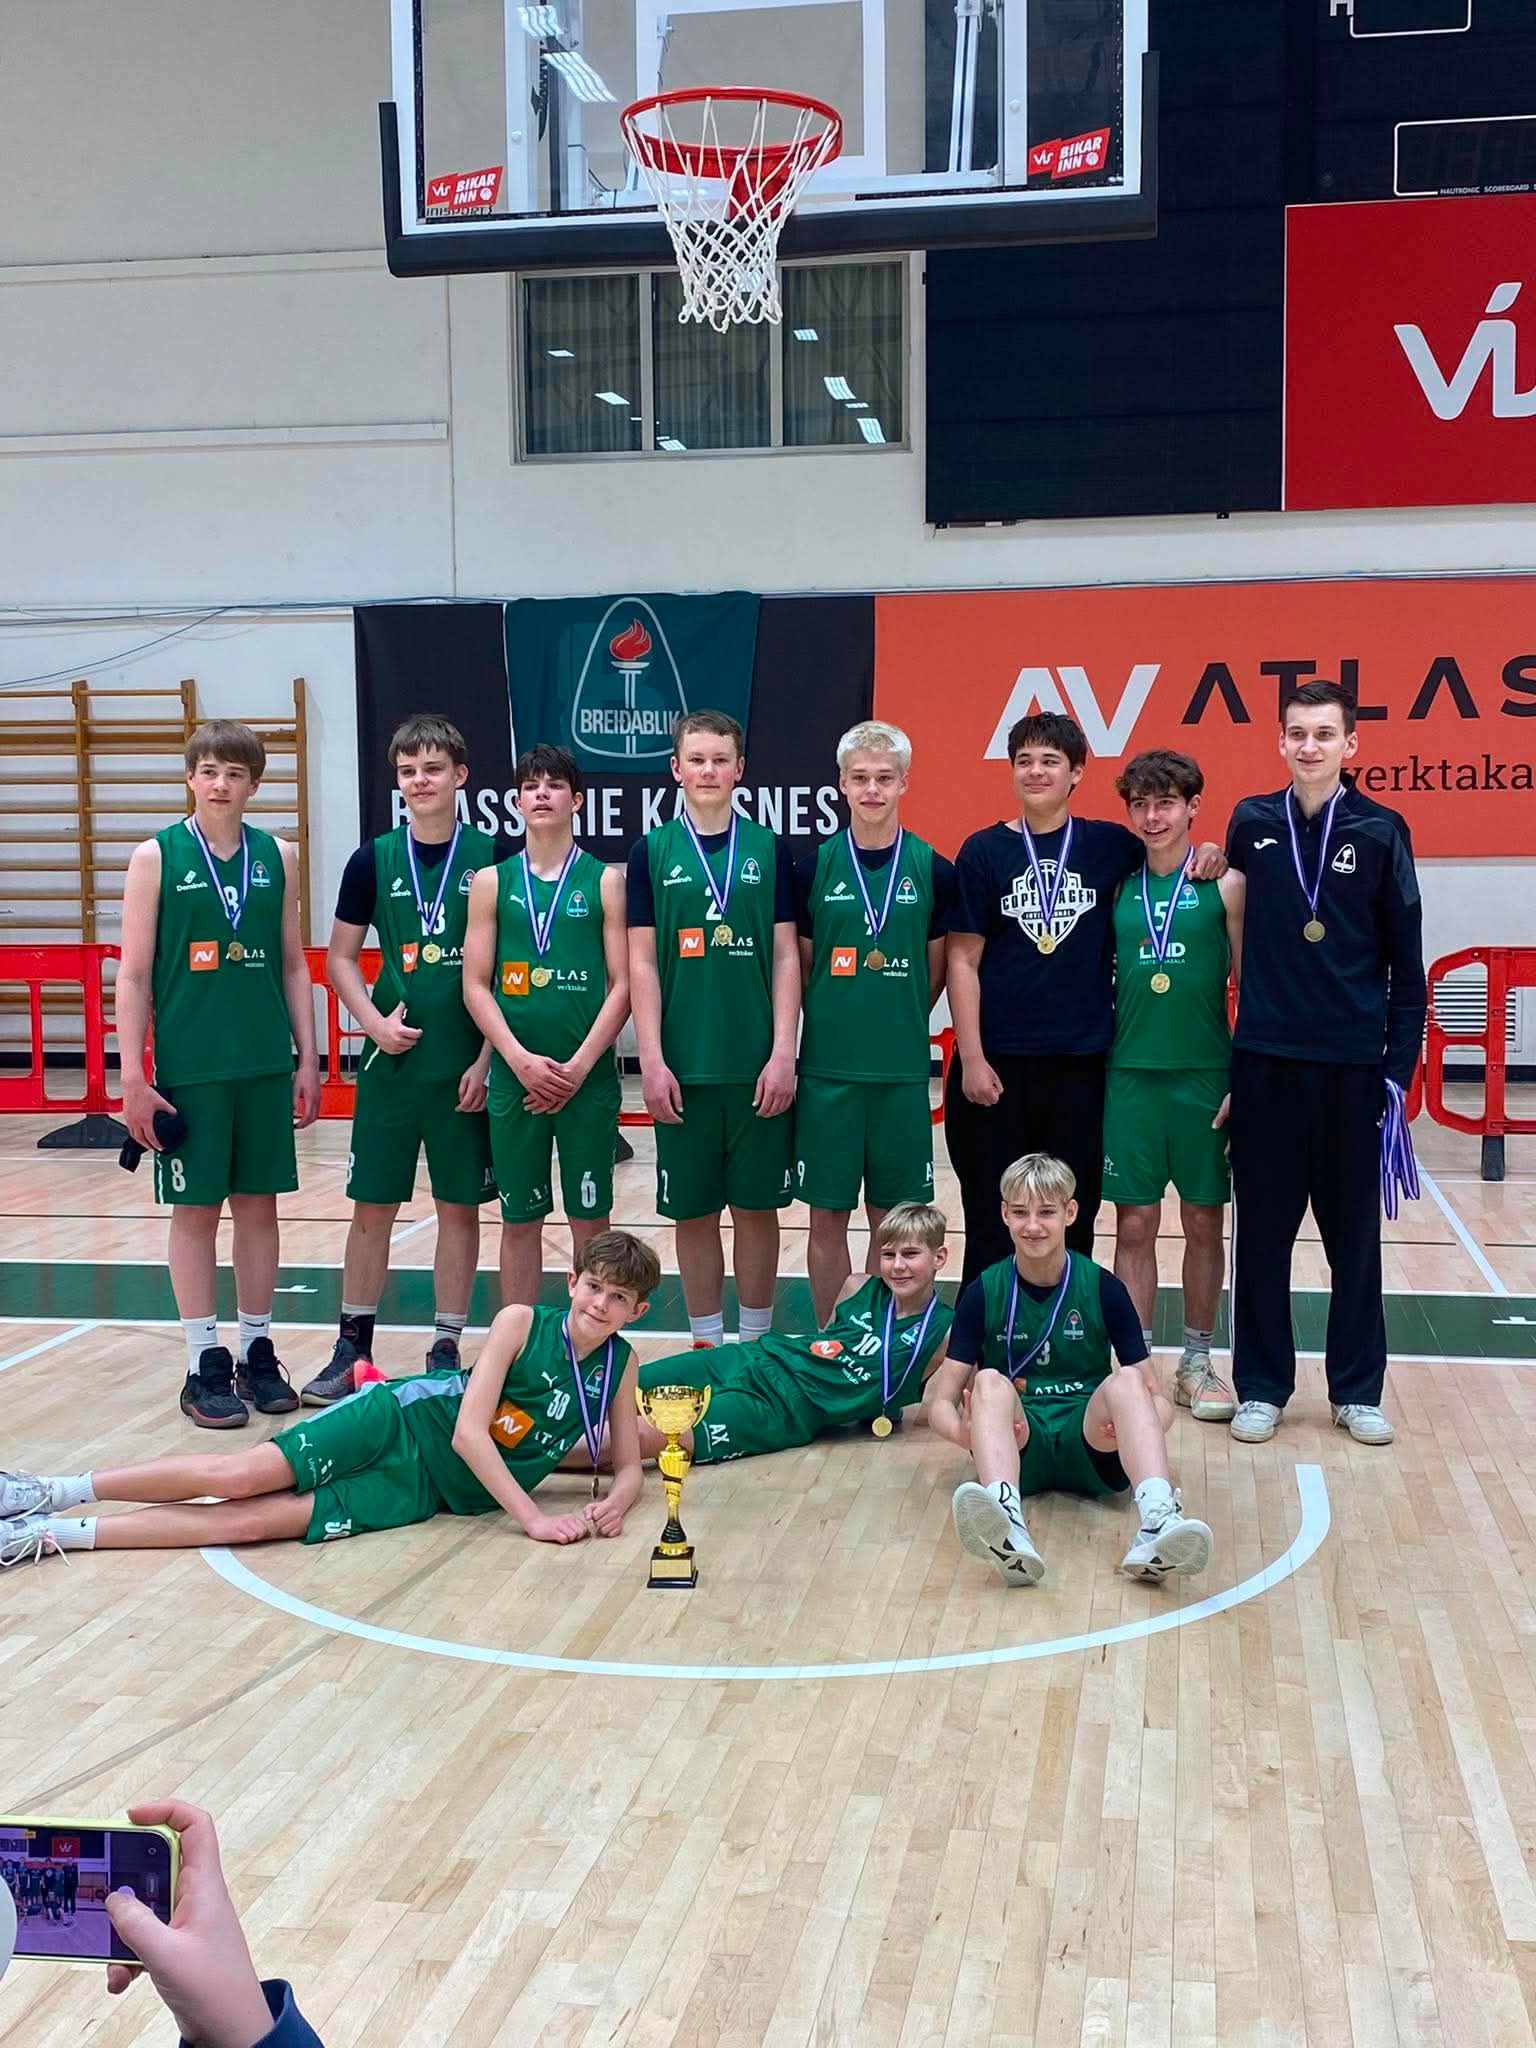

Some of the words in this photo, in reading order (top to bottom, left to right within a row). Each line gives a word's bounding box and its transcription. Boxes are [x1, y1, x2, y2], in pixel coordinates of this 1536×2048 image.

[1060, 136, 1103, 159] BIKAR
[1057, 154, 1083, 173] INN
[456, 173, 496, 193] BIKAR
[453, 190, 477, 205] INN
[1181, 654, 1536, 725] ATLAS
[391, 788, 624, 837] BASSIE
[641, 786, 839, 836] KSNES
[1002, 889, 1095, 911] COPEAGEN
[1154, 901, 1170, 932] 5
[710, 936, 754, 947] ALAS
[545, 968, 588, 981] TLAS
[170, 1158, 187, 1193] 8
[581, 1170, 597, 1209] 6
[851, 1333, 882, 1356] 10
[838, 1354, 872, 1382] TLAS
[1035, 1381, 1084, 1395] ATLAS
